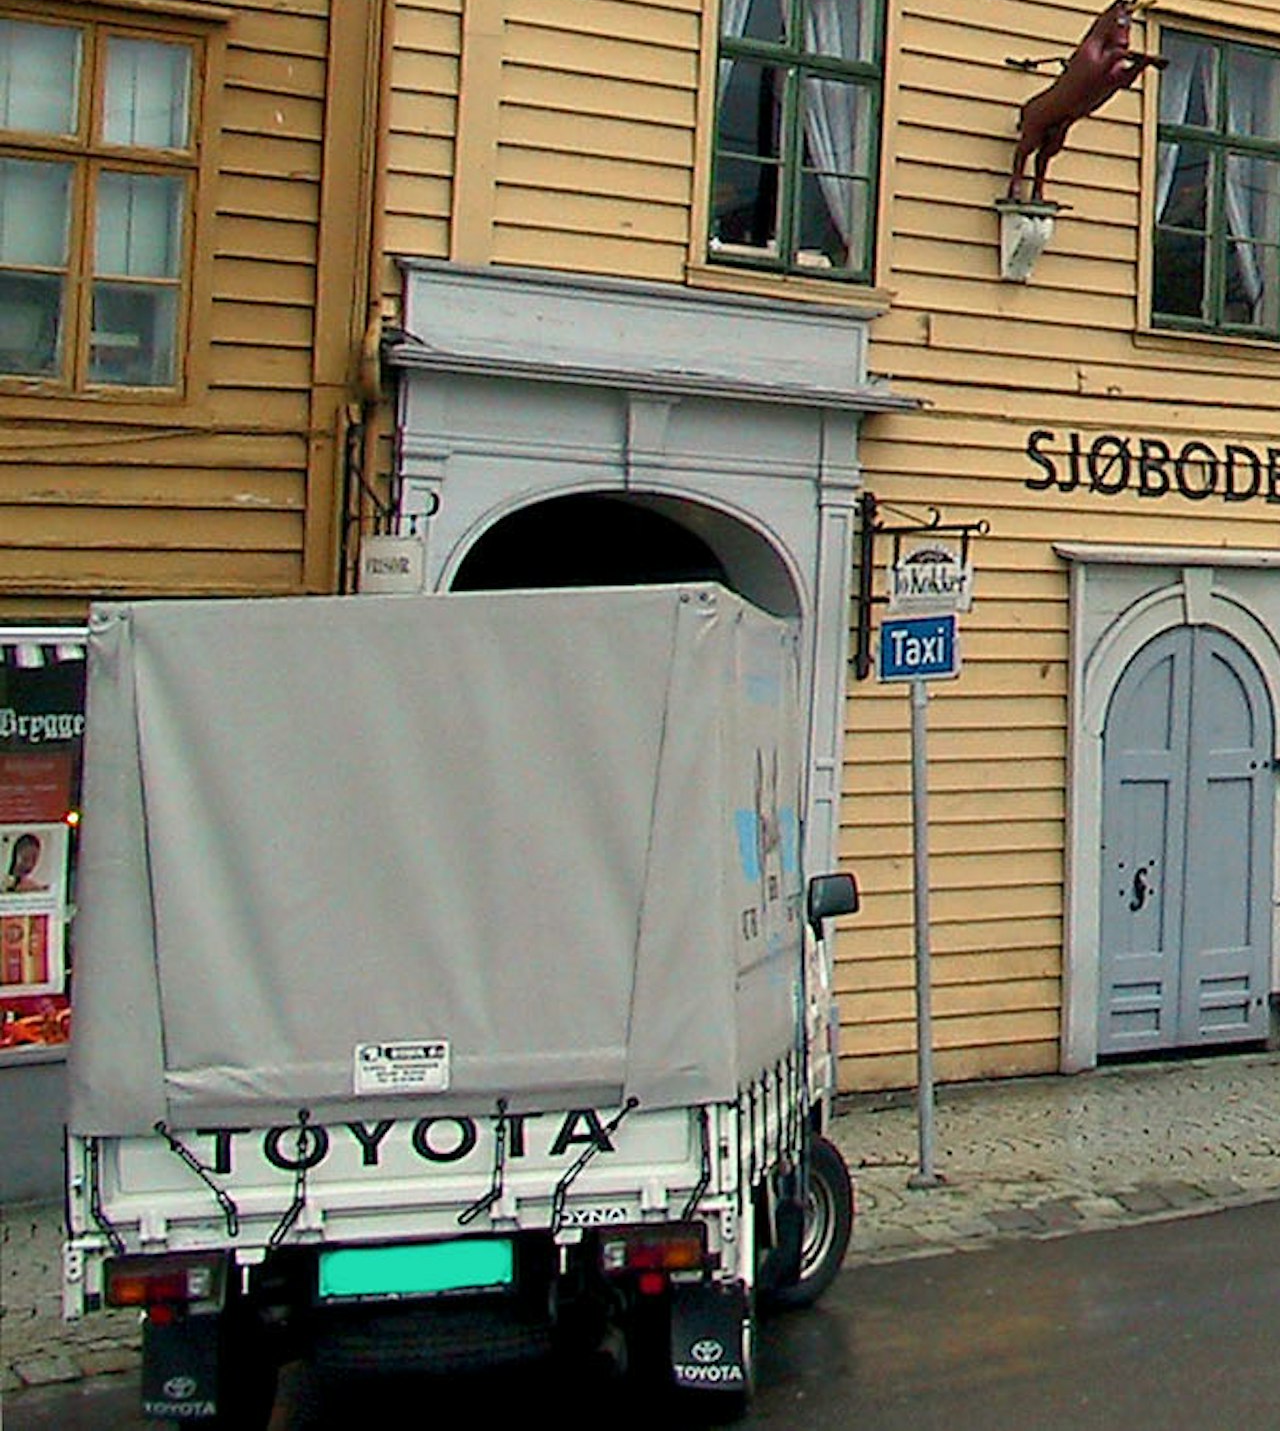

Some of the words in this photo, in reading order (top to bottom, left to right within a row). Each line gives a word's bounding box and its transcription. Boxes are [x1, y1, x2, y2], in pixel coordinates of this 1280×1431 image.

[891, 626, 946, 667] Taxi
[195, 1106, 616, 1175] TOYOTA
[674, 1362, 744, 1384] TOYOTA
[145, 1399, 217, 1419] TOYOTA
